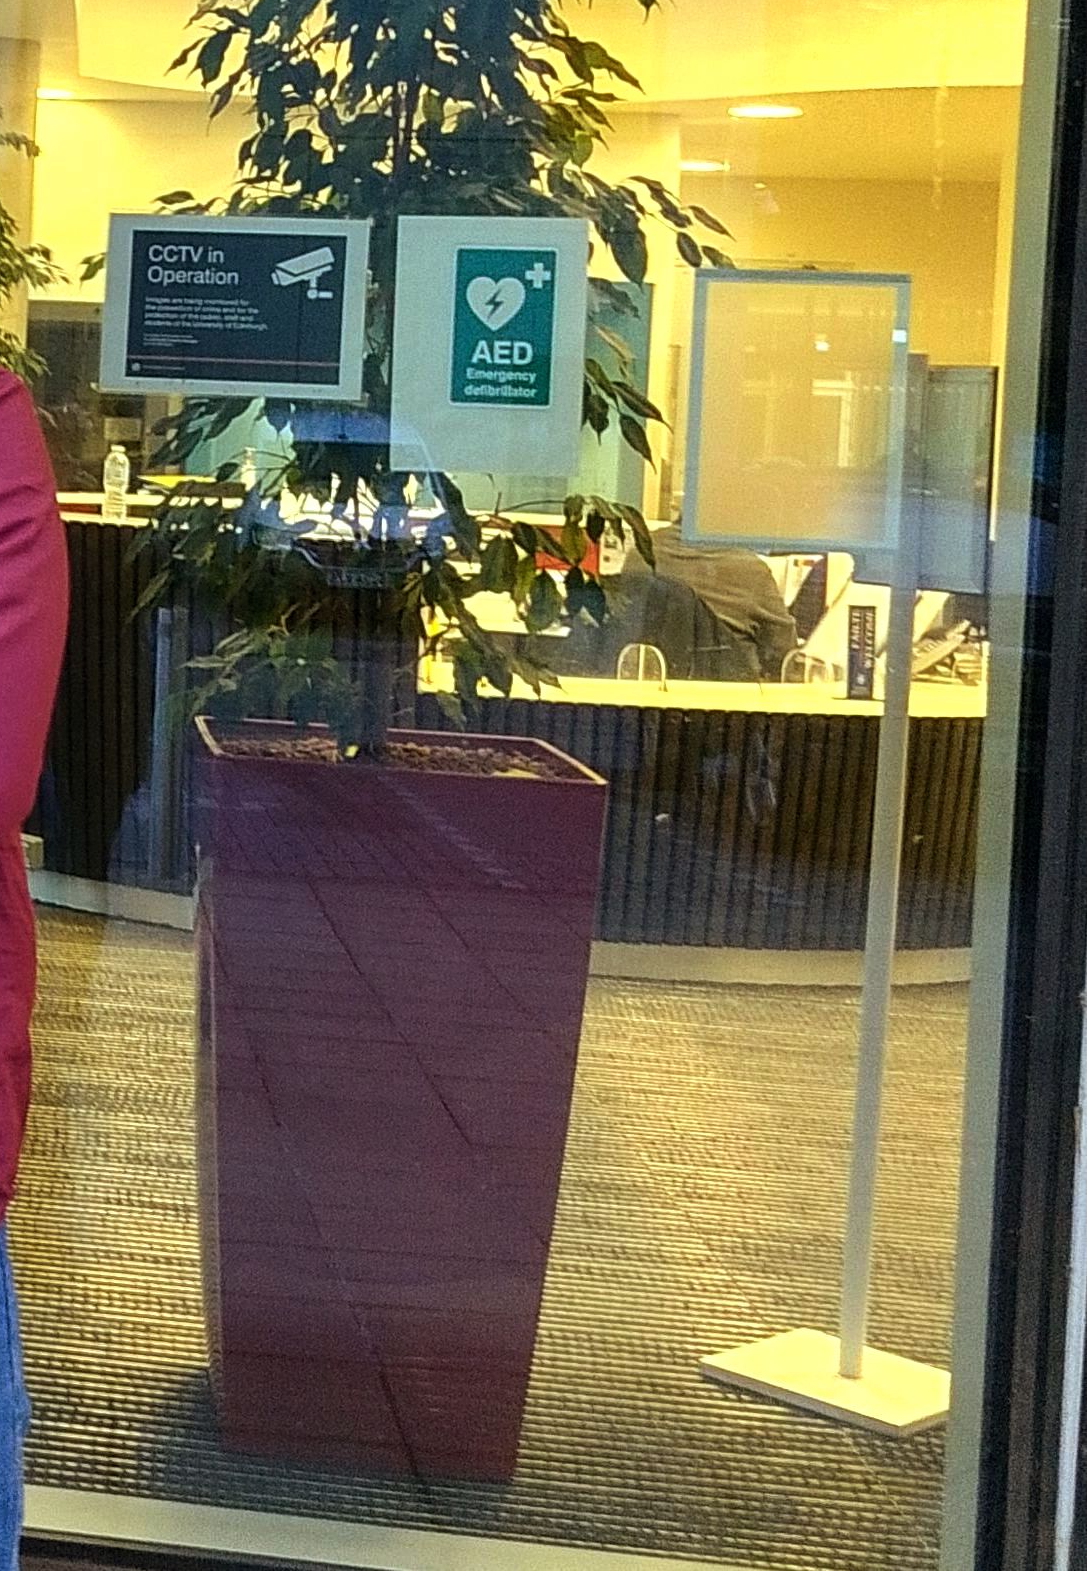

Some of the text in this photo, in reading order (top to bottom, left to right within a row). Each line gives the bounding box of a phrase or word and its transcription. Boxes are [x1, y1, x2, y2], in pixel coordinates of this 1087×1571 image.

[148, 244, 225, 264] CCTV in
[147, 265, 240, 287] Operation
[471, 340, 534, 365] AED
[466, 367, 537, 384] Emergency
[463, 384, 538, 398] defibrillator
